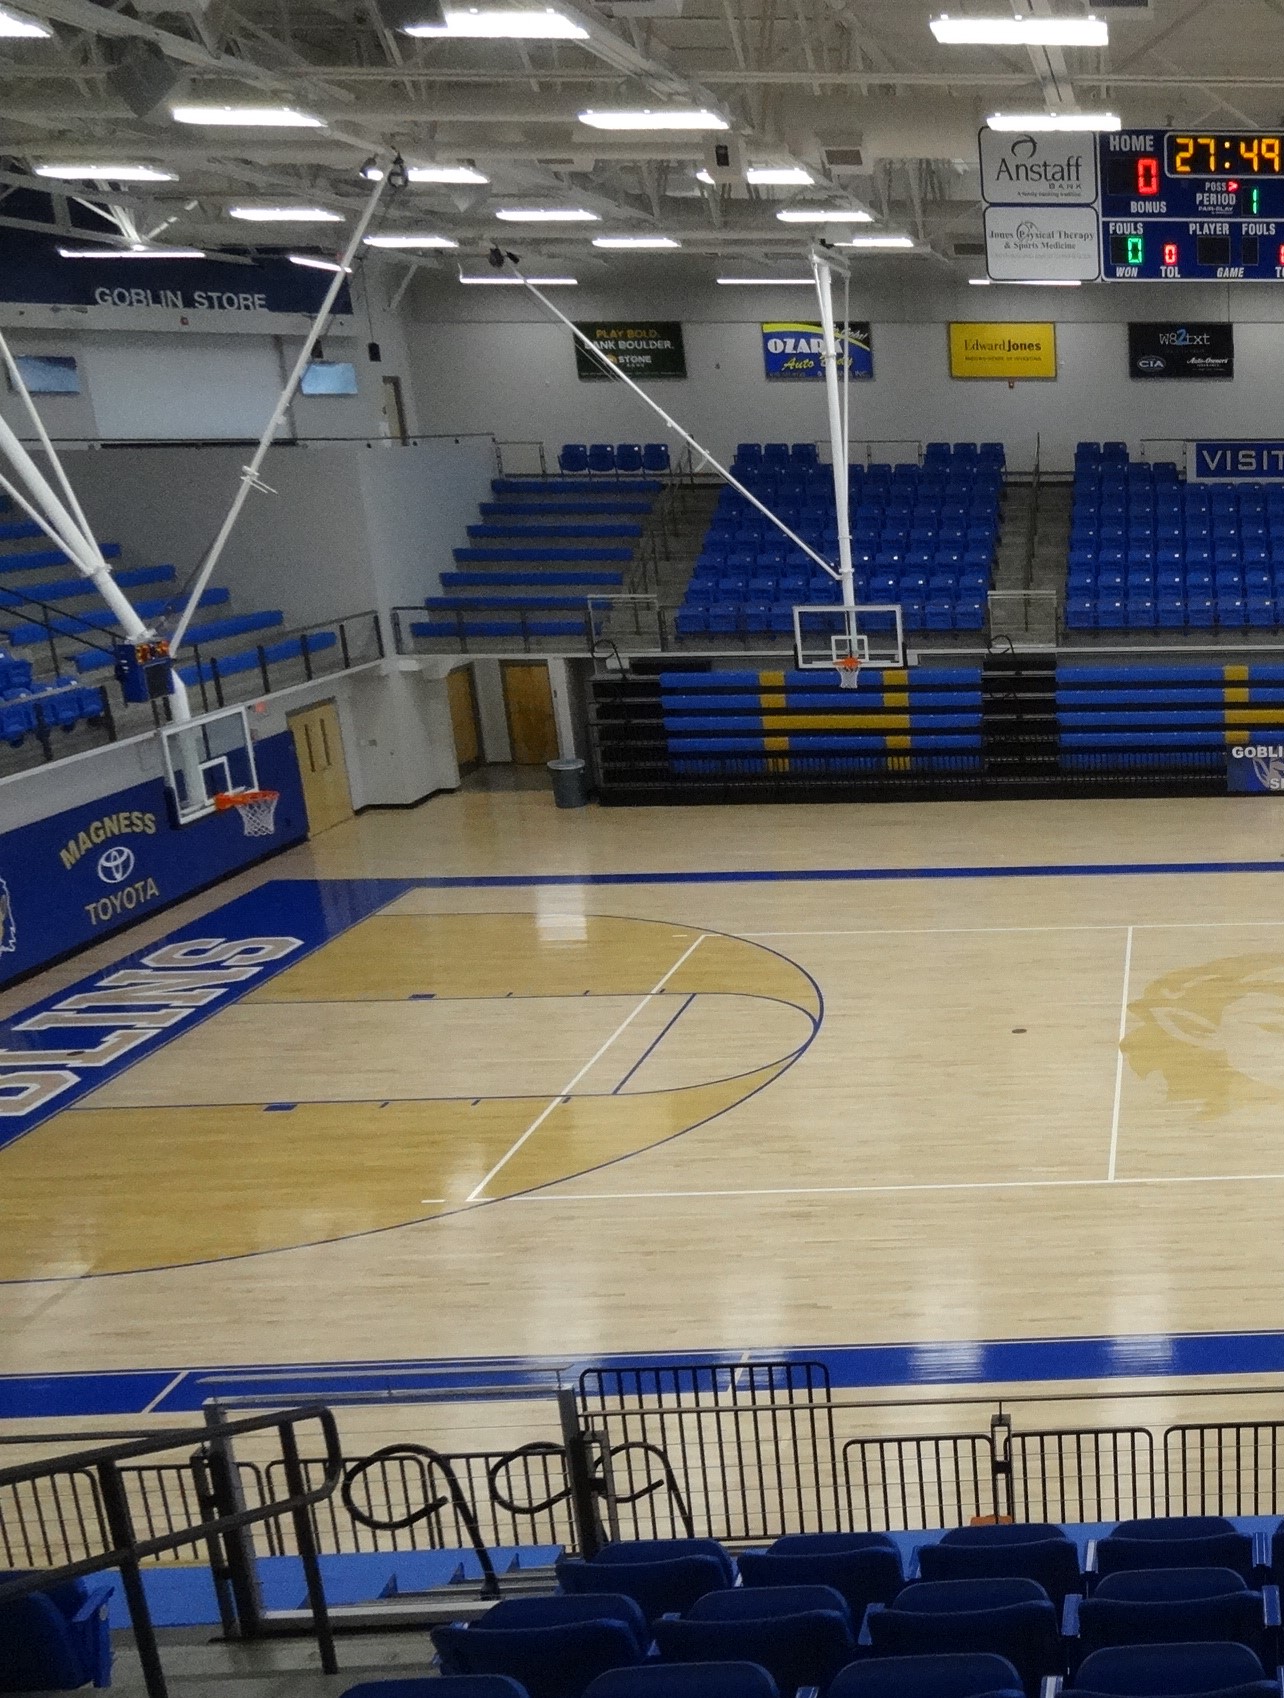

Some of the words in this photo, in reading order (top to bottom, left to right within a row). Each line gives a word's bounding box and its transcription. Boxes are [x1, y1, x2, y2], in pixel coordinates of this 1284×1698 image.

[1109, 135, 1154, 152] HOME
[1175, 138, 1280, 172] 27:49
[995, 155, 1083, 182] Anstaff
[1137, 159, 1158, 195] 0
[1205, 182, 1227, 191] POSS
[1196, 193, 1236, 205] PERIOD
[1130, 201, 1167, 213] BONUS
[1109, 222, 1144, 235] FOULS
[1189, 223, 1230, 235] PLAYER
[1242, 223, 1276, 235] FOULS
[1128, 238, 1142, 263] 0
[1164, 245, 1177, 264] 0
[1116, 267, 1138, 277] WON
[1160, 267, 1180, 278] TOL
[1216, 268, 1244, 278] GAME
[95, 288, 183, 308] GOBLIN
[193, 291, 266, 310] STORE
[596, 330, 623, 339] PLAY
[618, 341, 674, 349] BOULDER.
[1006, 340, 1041, 352] Jones
[618, 355, 651, 363] STONE
[782, 356, 814, 370] Auto
[59, 812, 156, 870] MAGNESS
[84, 877, 160, 926] TOYOTA
